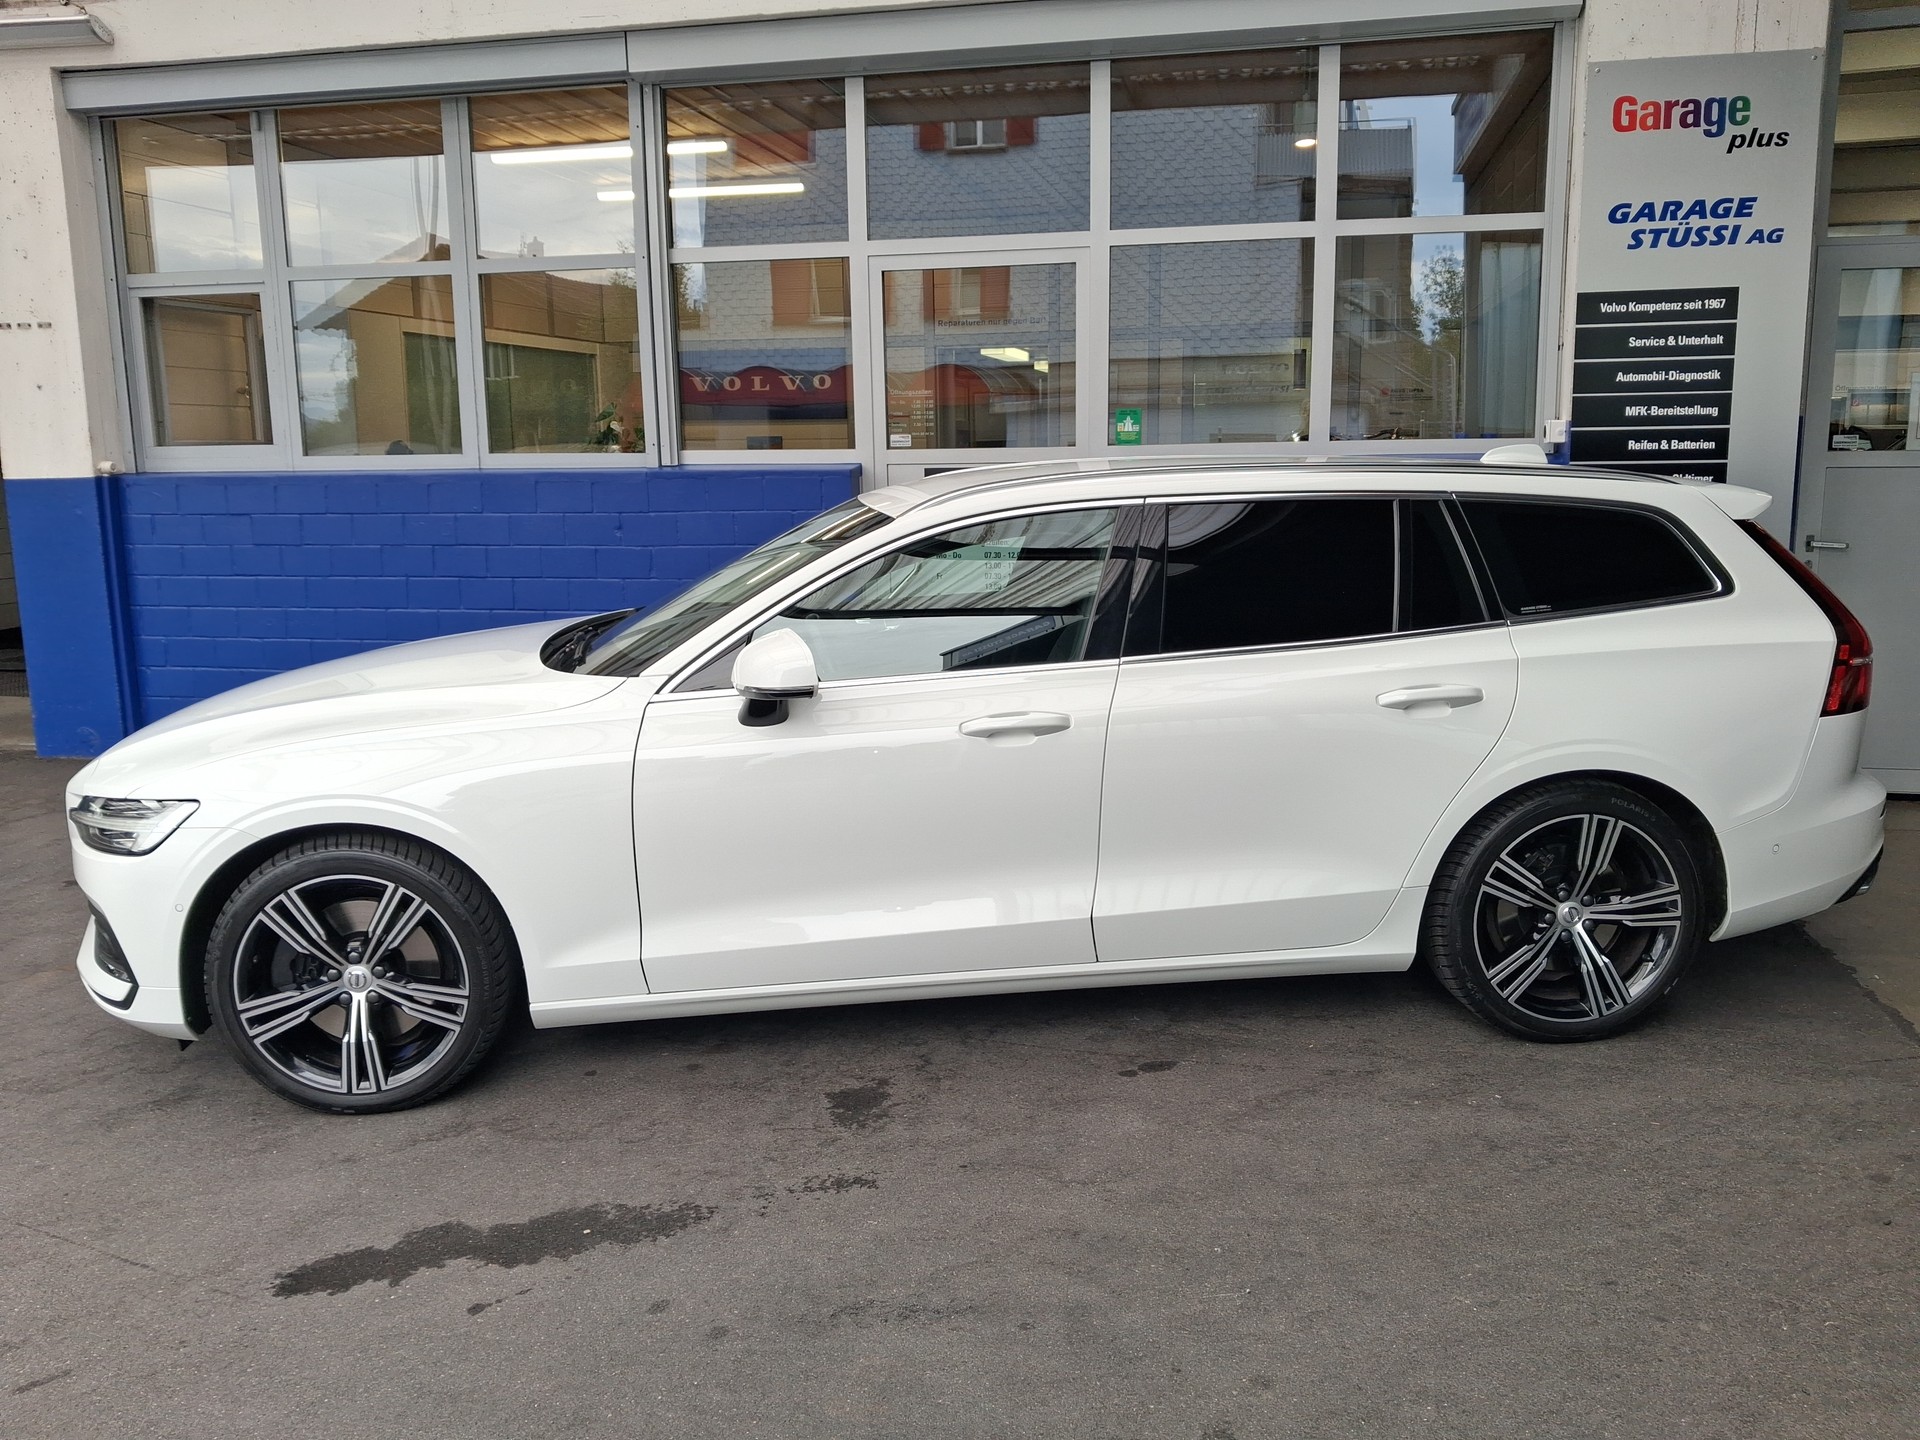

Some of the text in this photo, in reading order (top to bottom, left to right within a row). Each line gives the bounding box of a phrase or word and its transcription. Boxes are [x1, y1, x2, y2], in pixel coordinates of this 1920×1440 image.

[1612, 95, 1752, 138] Garage
[1726, 128, 1790, 154] plus
[1607, 196, 1758, 224] GARAGE
[1626, 222, 1785, 250] STÜSSI AG
[1600, 298, 1726, 314] Volvo Kompetenz seit 1967
[937, 319, 986, 328] Reparaturen
[1628, 334, 1724, 347] Service & Unterhalt
[689, 374, 832, 391] VOLVO
[1615, 369, 1721, 383] Automobil-Diagnostik
[1625, 404, 1719, 417] MFK-Bereitstellung
[1628, 438, 1716, 450] Reifen & Batterien
[984, 551, 1002, 559] 07.30
[984, 562, 1002, 570] 13.00
[984, 572, 1002, 580] 07.30
